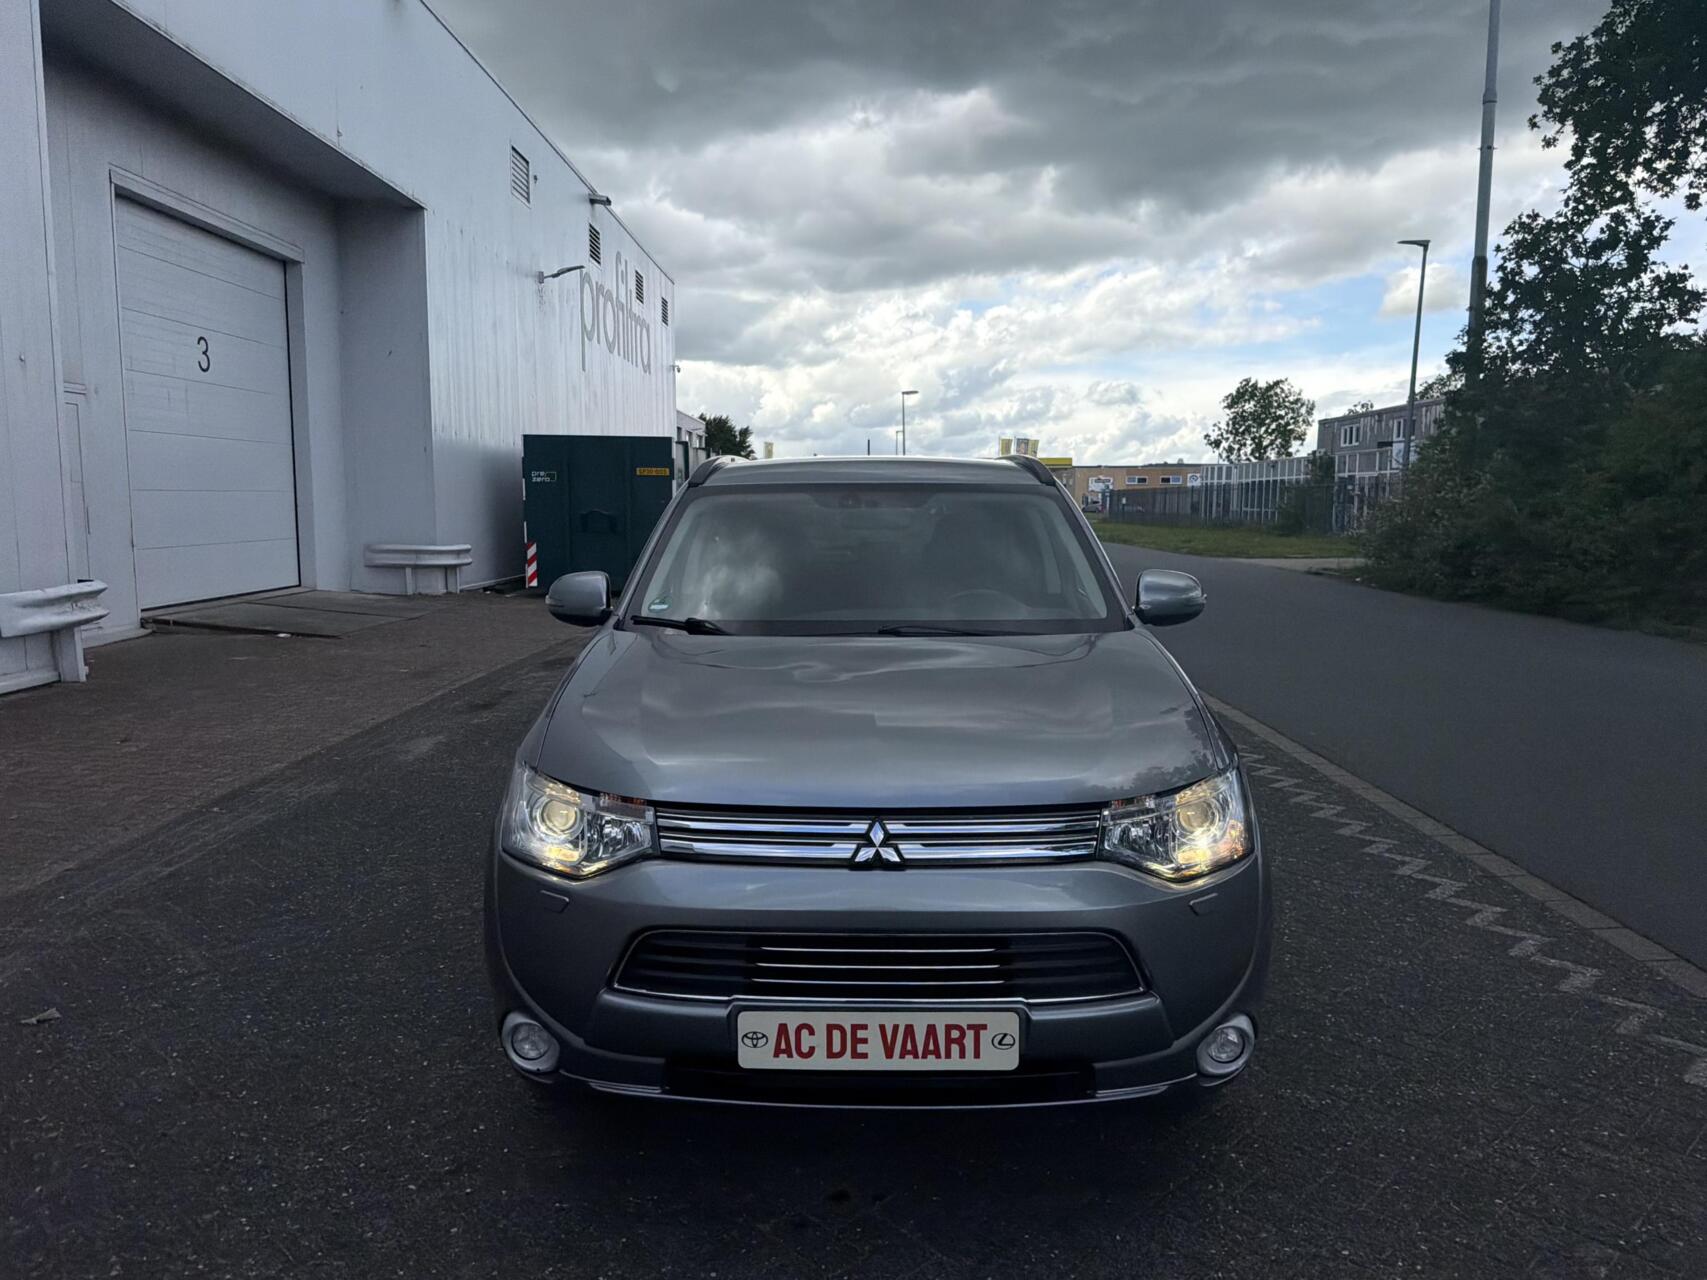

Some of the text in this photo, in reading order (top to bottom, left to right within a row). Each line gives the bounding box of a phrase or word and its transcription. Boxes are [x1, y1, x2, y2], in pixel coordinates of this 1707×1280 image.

[579, 250, 651, 375] profiltra
[197, 336, 210, 373] 3
[772, 1022, 988, 1059] AC DE VAART
